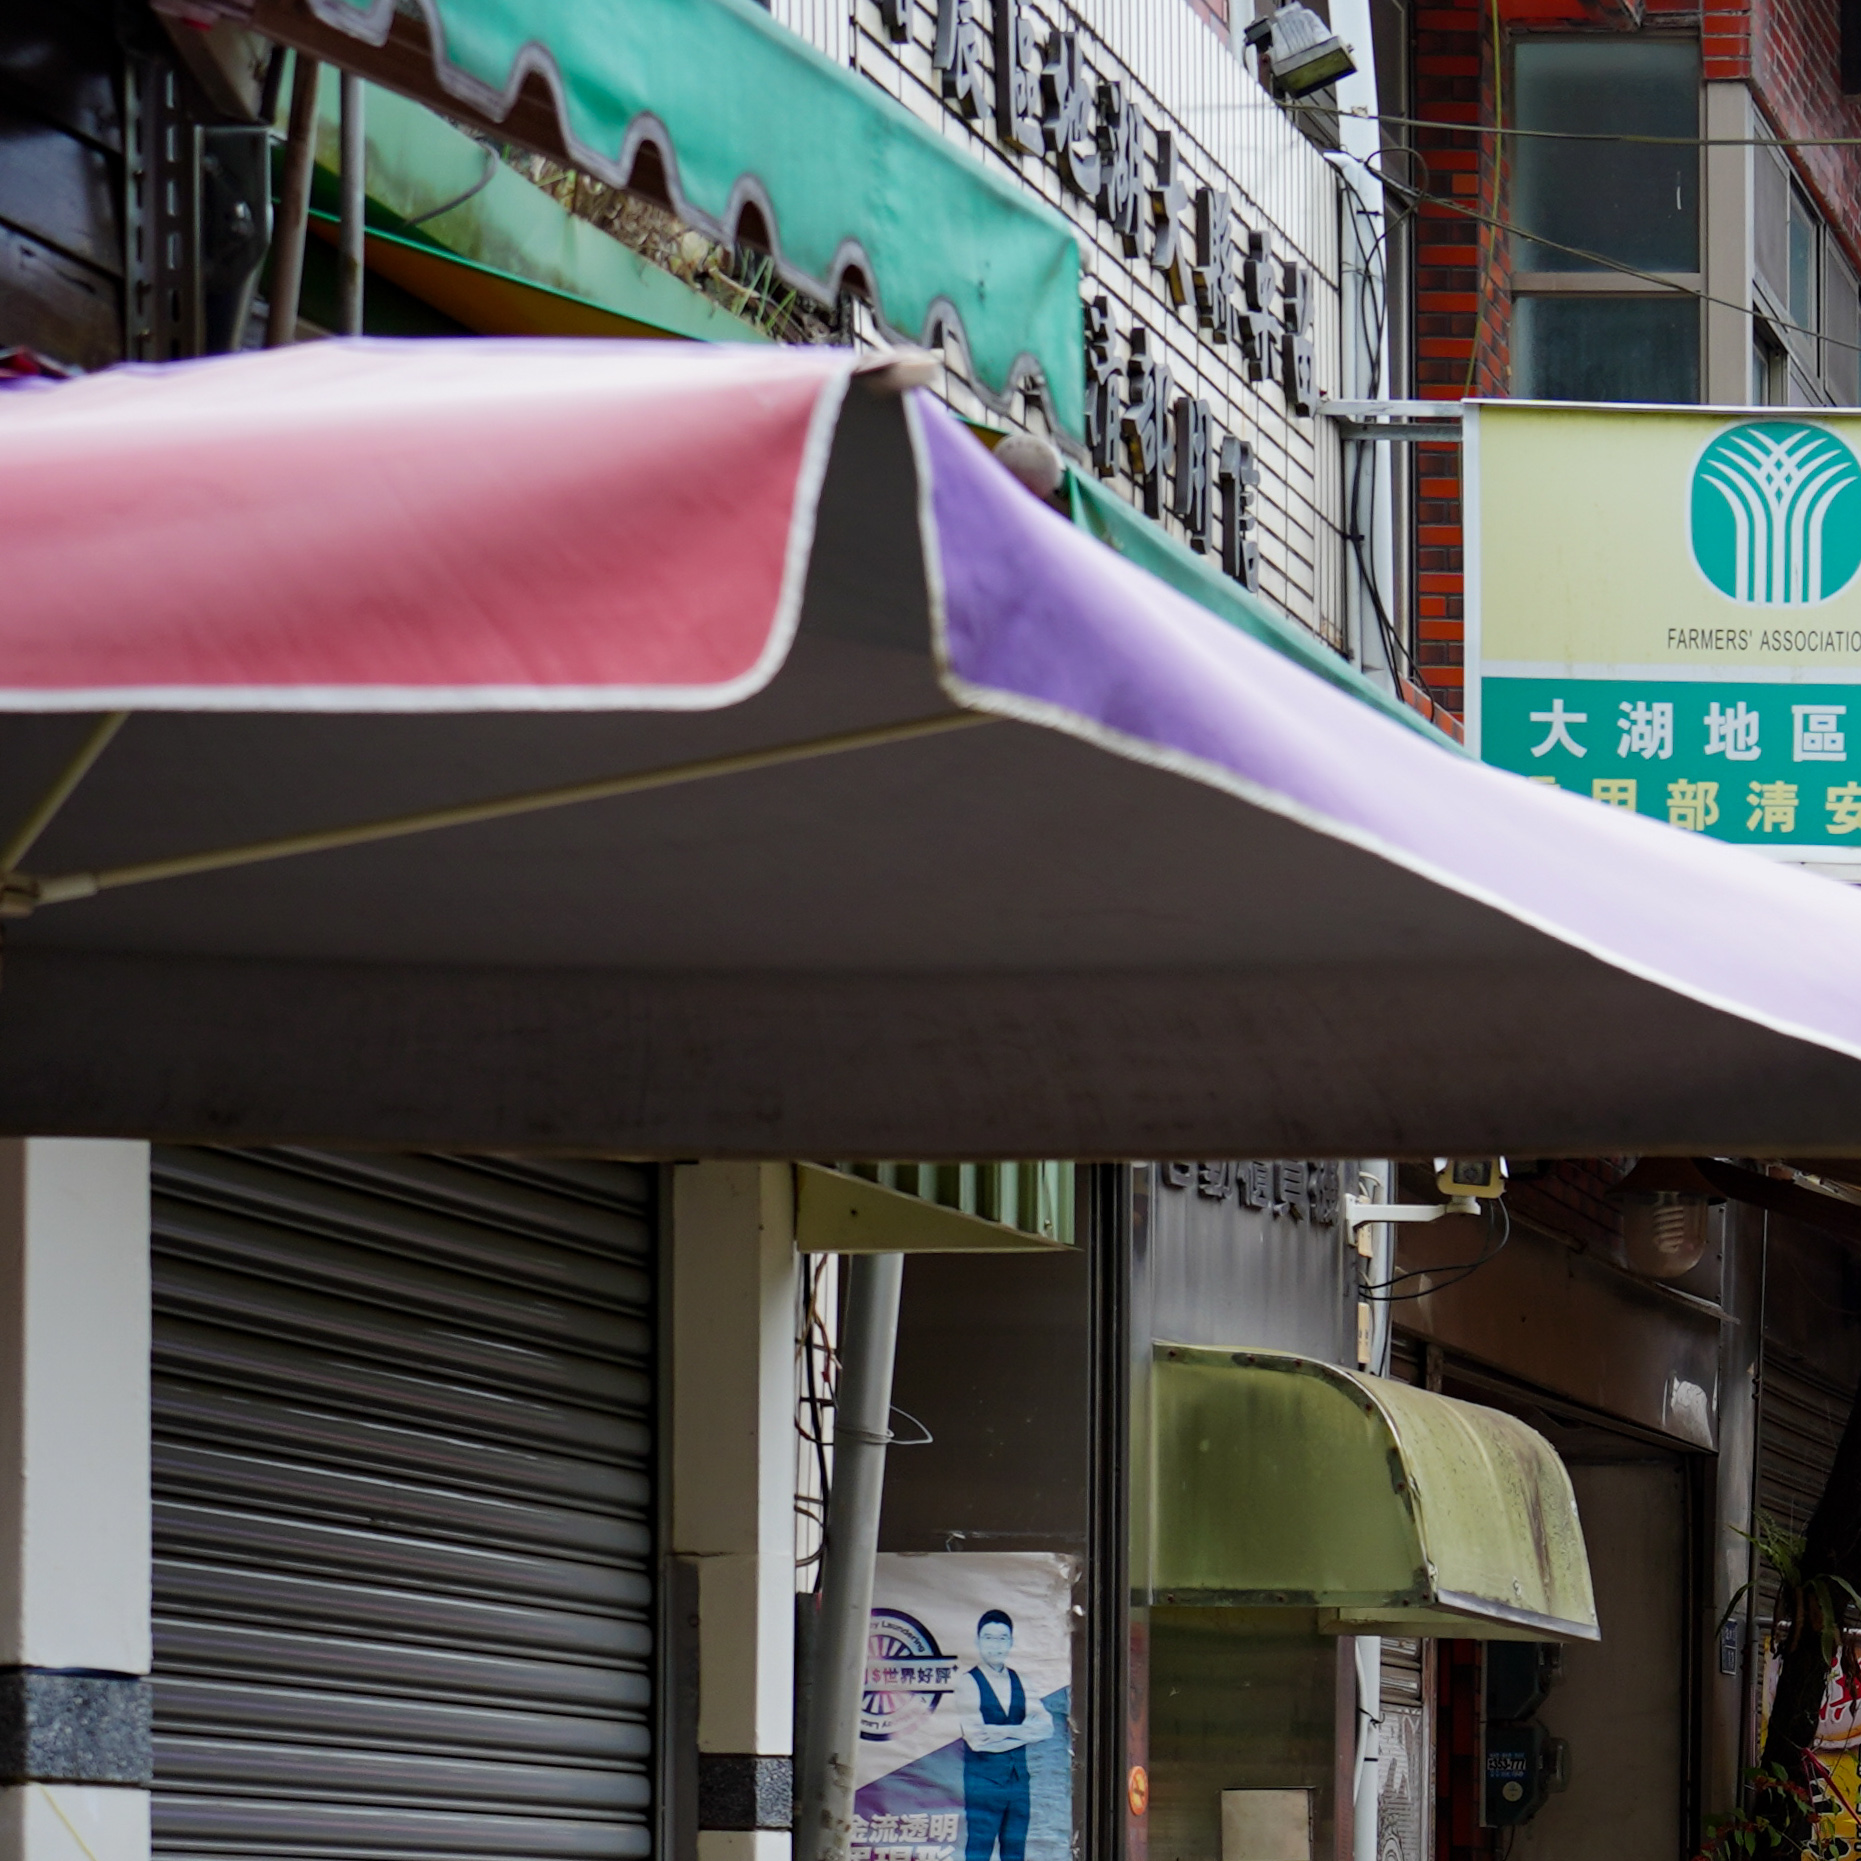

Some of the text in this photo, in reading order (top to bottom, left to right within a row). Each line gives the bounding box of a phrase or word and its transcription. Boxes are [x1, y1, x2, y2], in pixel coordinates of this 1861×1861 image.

[1667, 628, 1753, 651] FARMERS'
[864, 1667, 952, 1685] $世界好評
[851, 1813, 959, 1843] 金流透明
